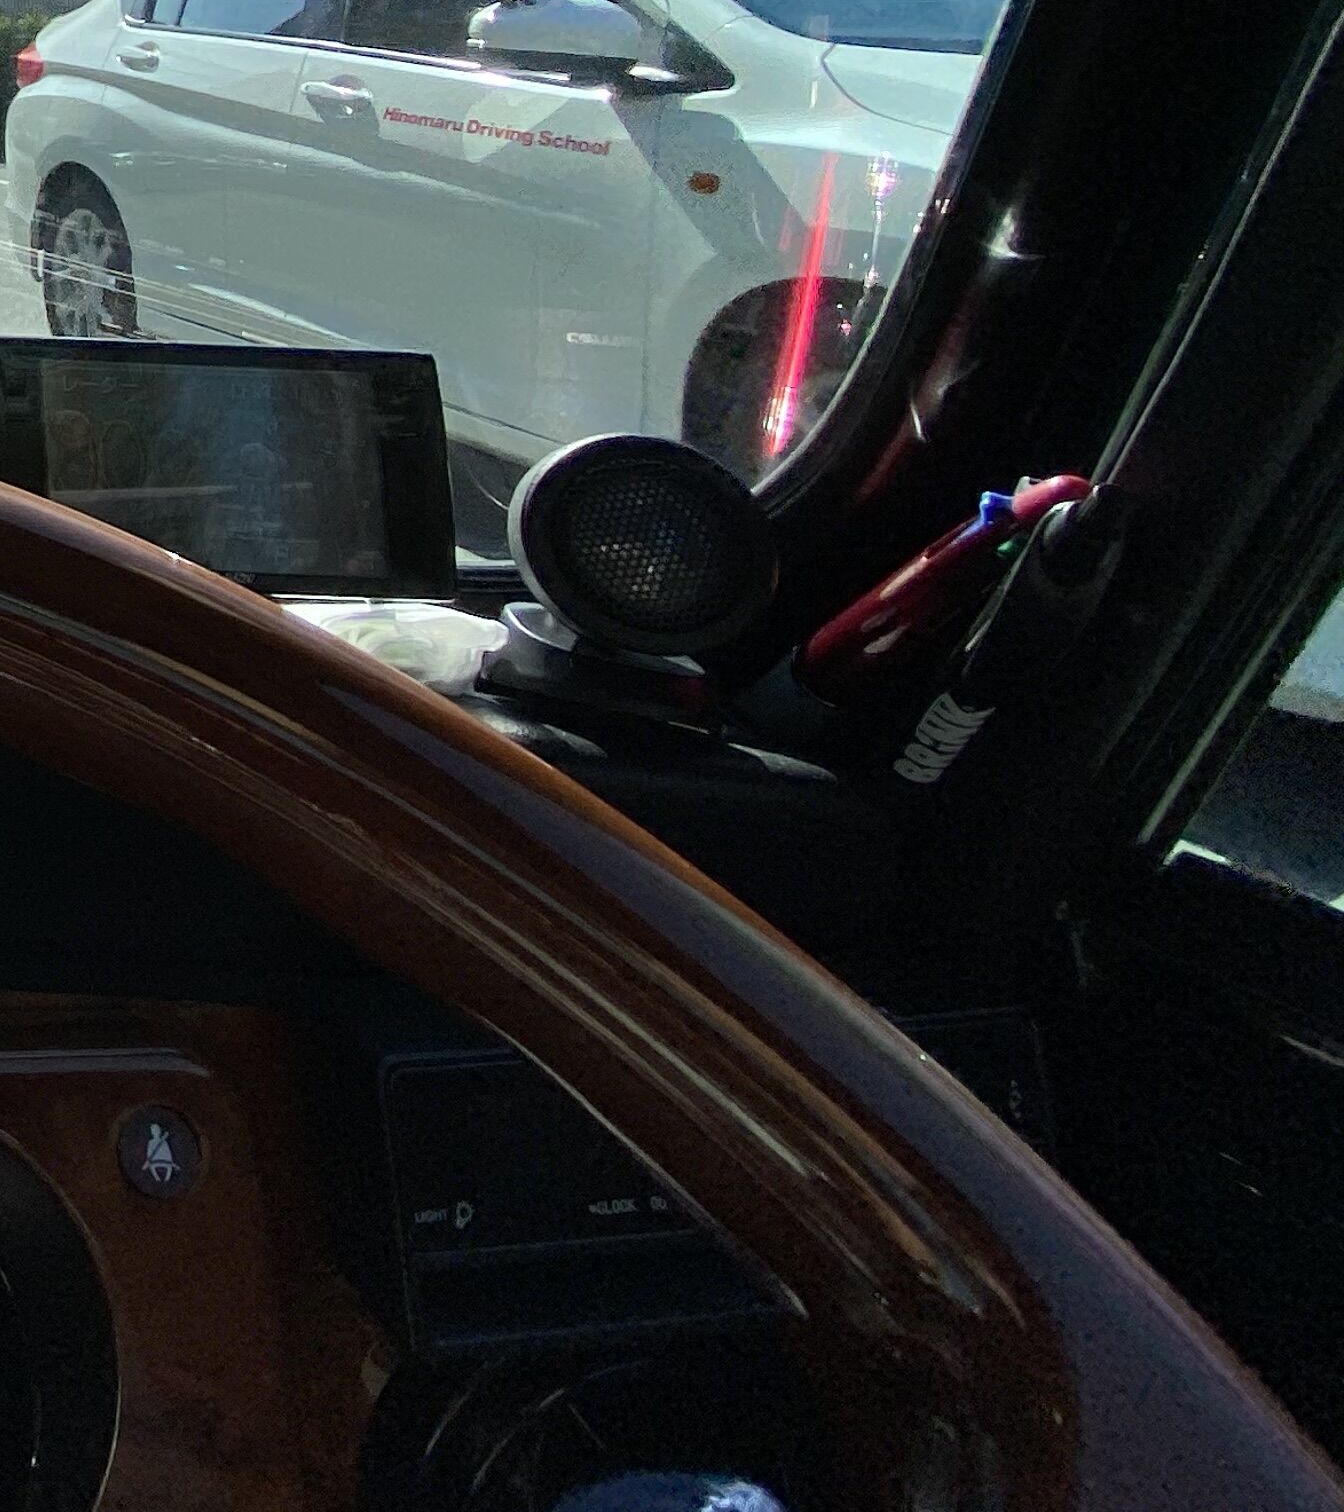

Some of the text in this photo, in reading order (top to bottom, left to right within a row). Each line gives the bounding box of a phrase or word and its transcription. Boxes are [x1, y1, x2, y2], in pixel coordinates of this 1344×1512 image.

[383, 106, 611, 156] Hinomaru Driving School
